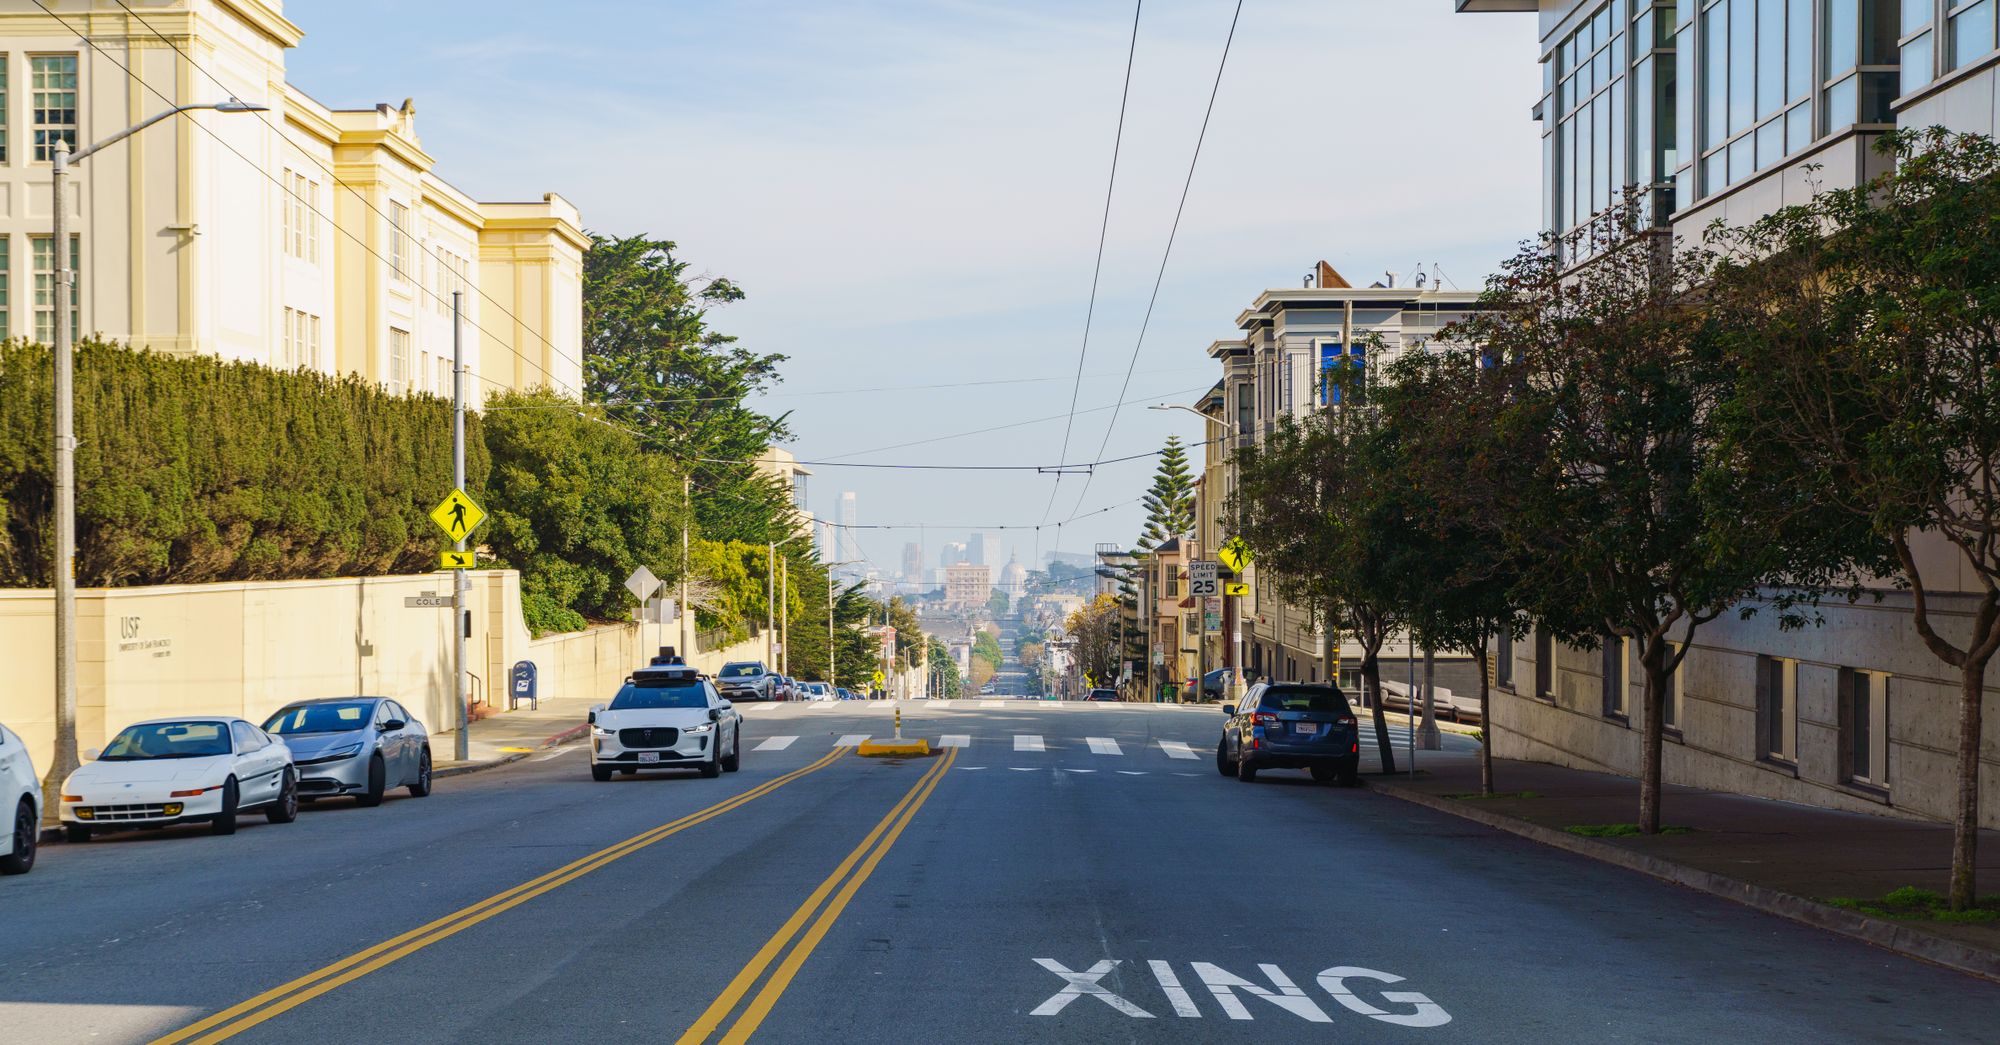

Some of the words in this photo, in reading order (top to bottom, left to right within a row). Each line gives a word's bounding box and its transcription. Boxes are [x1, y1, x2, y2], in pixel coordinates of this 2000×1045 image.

[1193, 580, 1215, 593] 25
[416, 598, 441, 606] COLE
[120, 616, 141, 639] USF
[1029, 958, 1452, 1028] XING
